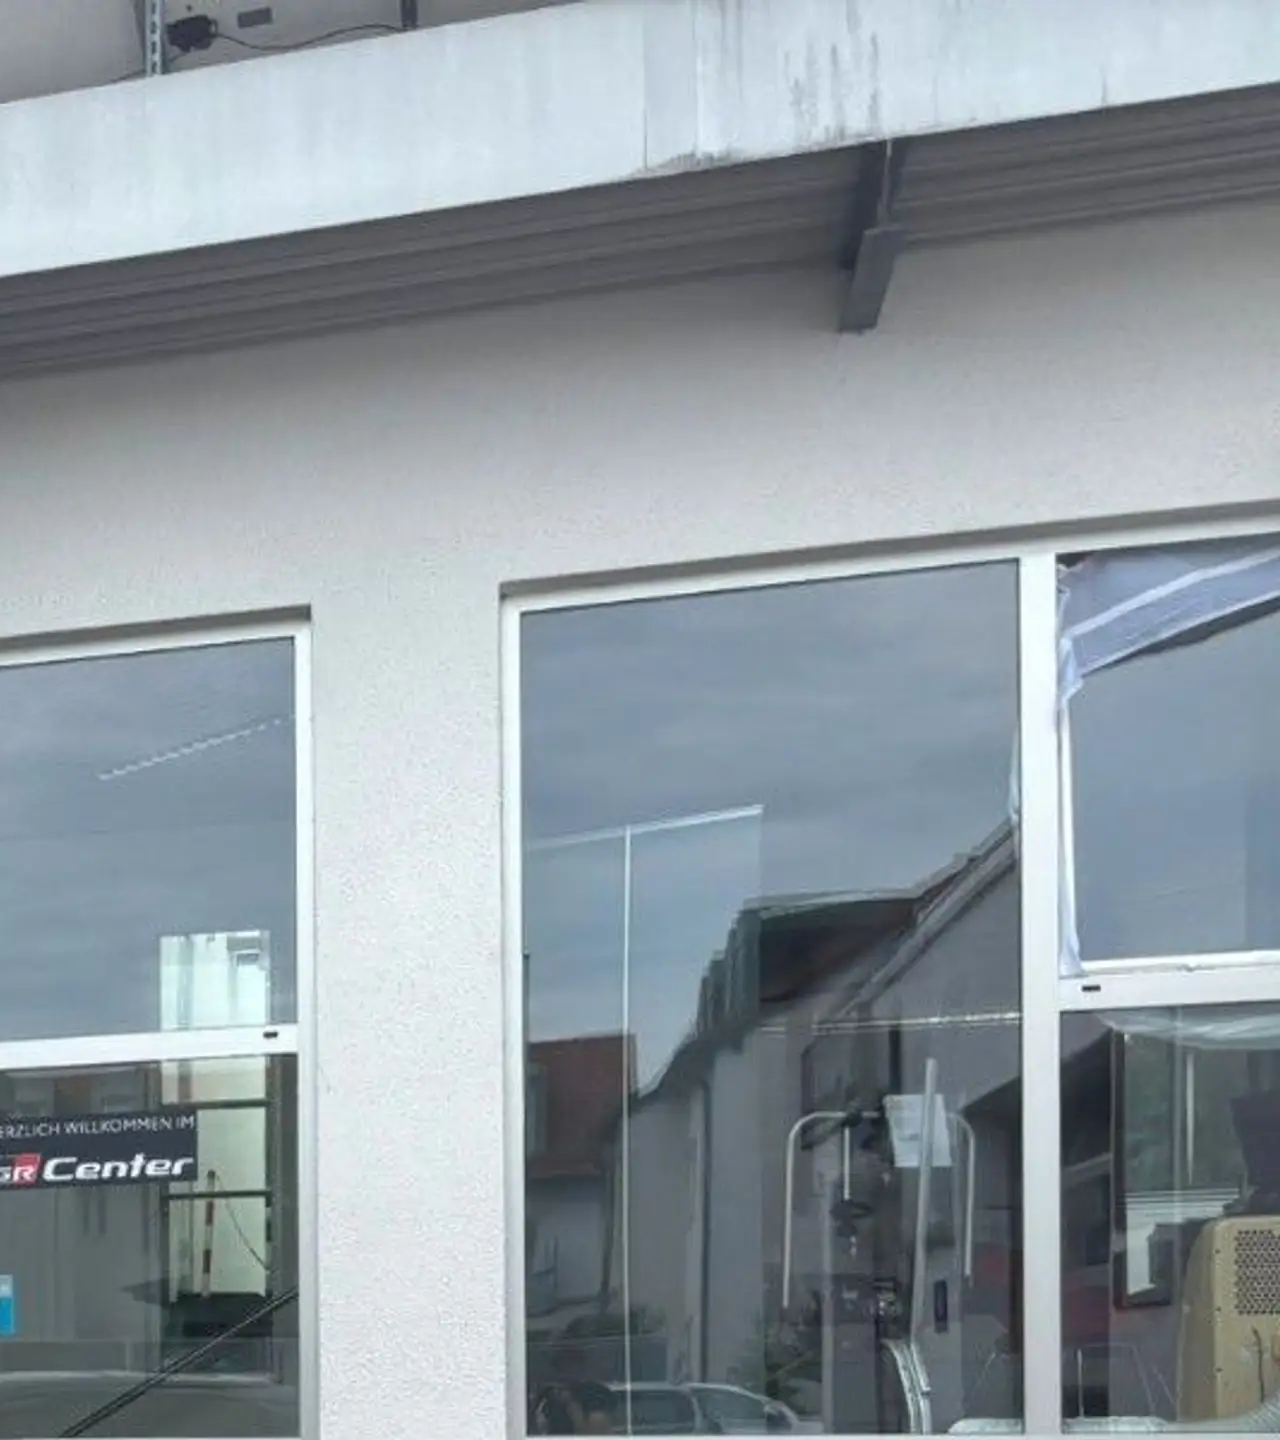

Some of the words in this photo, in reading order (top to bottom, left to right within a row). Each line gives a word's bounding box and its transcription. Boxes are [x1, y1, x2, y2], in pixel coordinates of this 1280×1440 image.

[63, 1115, 173, 1136] WILLKOMMEN
[176, 1114, 195, 1130] IM
[42, 1153, 195, 1182] Center
